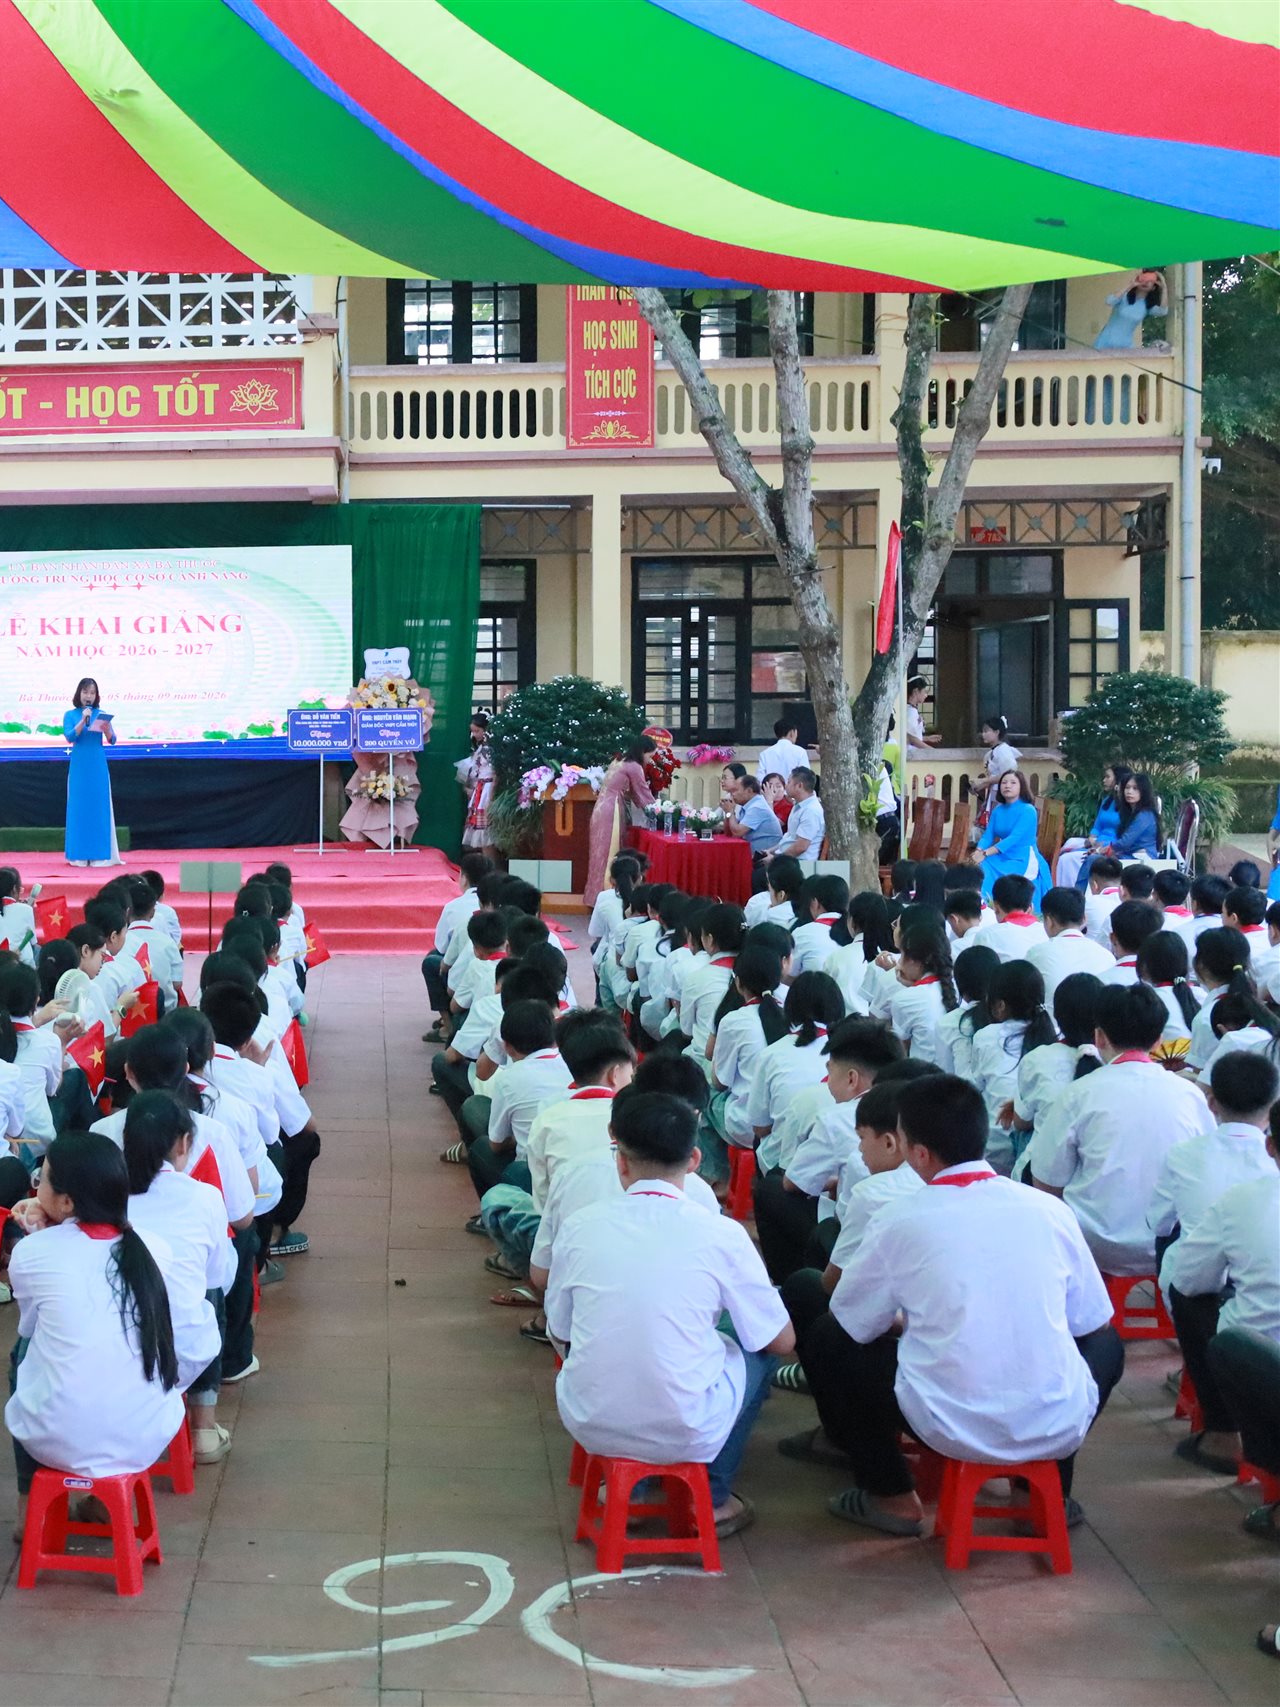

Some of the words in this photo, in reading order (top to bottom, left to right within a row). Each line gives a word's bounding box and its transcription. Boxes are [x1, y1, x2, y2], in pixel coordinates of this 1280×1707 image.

[583, 320, 606, 356] HỌC
[610, 320, 638, 350] SINH
[66, 385, 141, 425] HỌC
[153, 372, 220, 417] TỐT
[584, 364, 610, 399] TÍCH
[613, 366, 637, 404] CỰC
[39, 616, 122, 636] KHAI
[133, 609, 242, 635] GIẢNG
[16, 643, 62, 658] NĂM
[69, 644, 112, 660] HỌC
[118, 643, 157, 657] 2026
[175, 643, 214, 656] 2027
